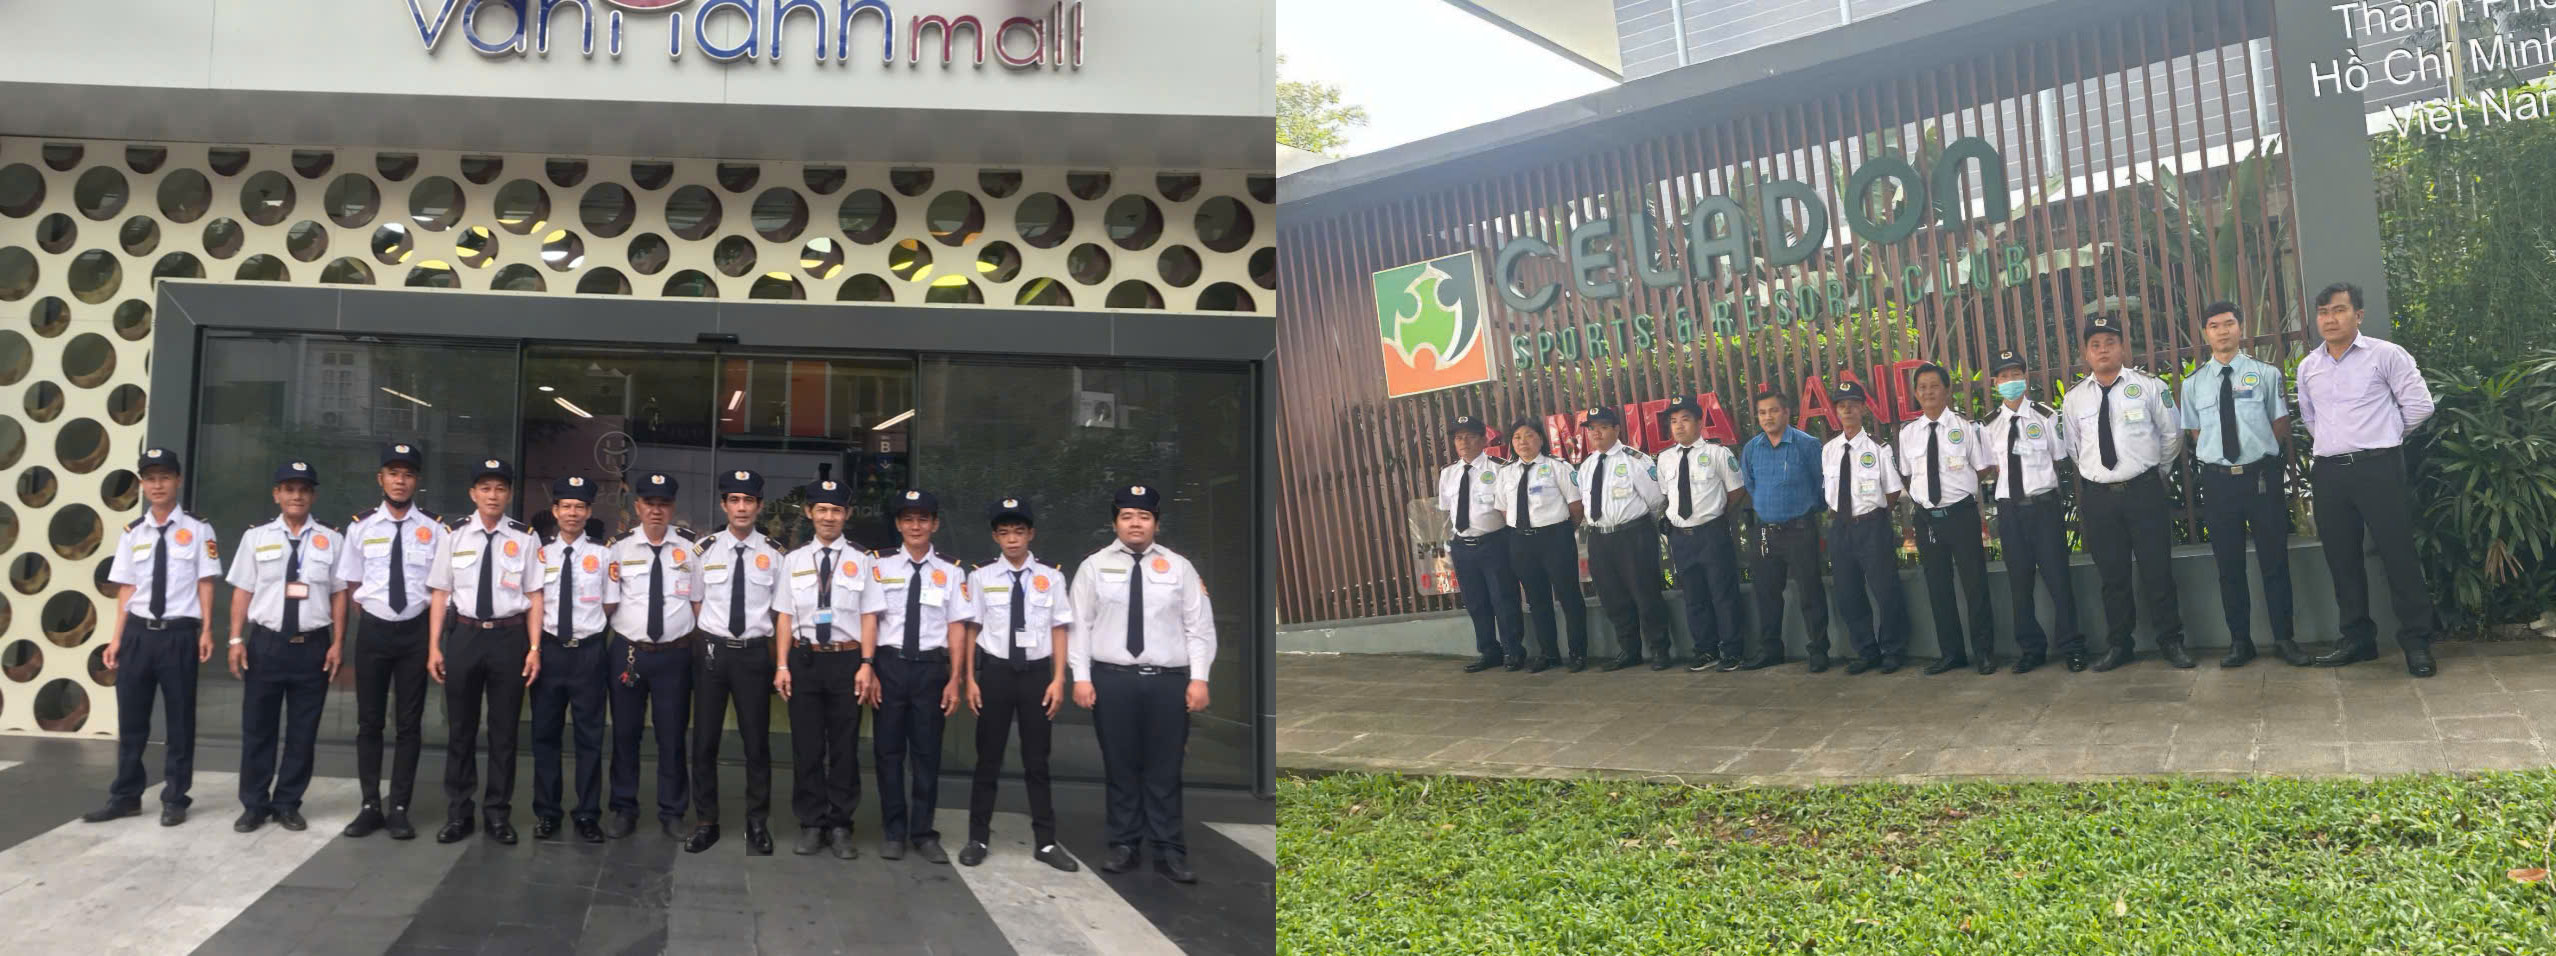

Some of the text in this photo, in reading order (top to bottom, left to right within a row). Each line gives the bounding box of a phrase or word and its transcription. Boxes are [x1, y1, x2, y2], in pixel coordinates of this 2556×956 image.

[908, 1, 1085, 68] mall
[1496, 136, 2010, 313] CELADON
[1513, 244, 2029, 370] SPORTS & RESORT CLUB
